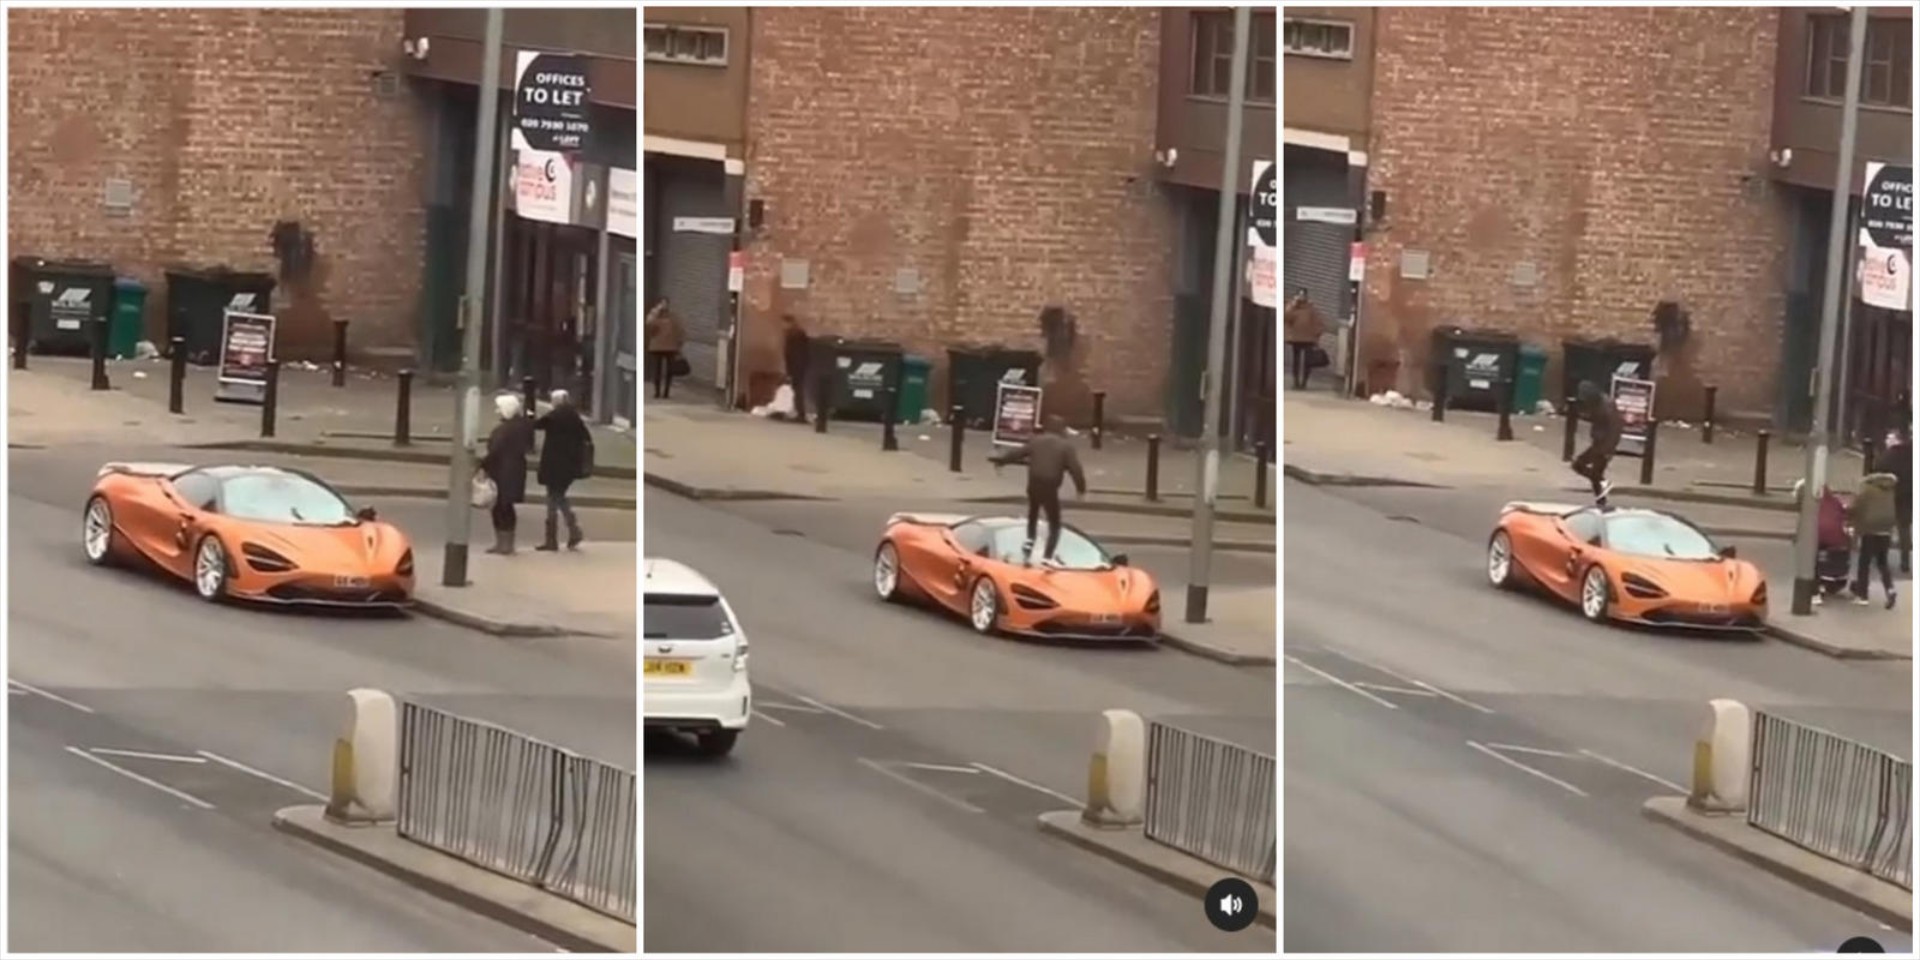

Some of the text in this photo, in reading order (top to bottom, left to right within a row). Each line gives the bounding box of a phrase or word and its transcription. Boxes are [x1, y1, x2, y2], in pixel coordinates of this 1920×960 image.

[536, 73, 585, 87] OFFICES
[524, 88, 583, 106] TO LET
[1871, 193, 1913, 210] TO LE
